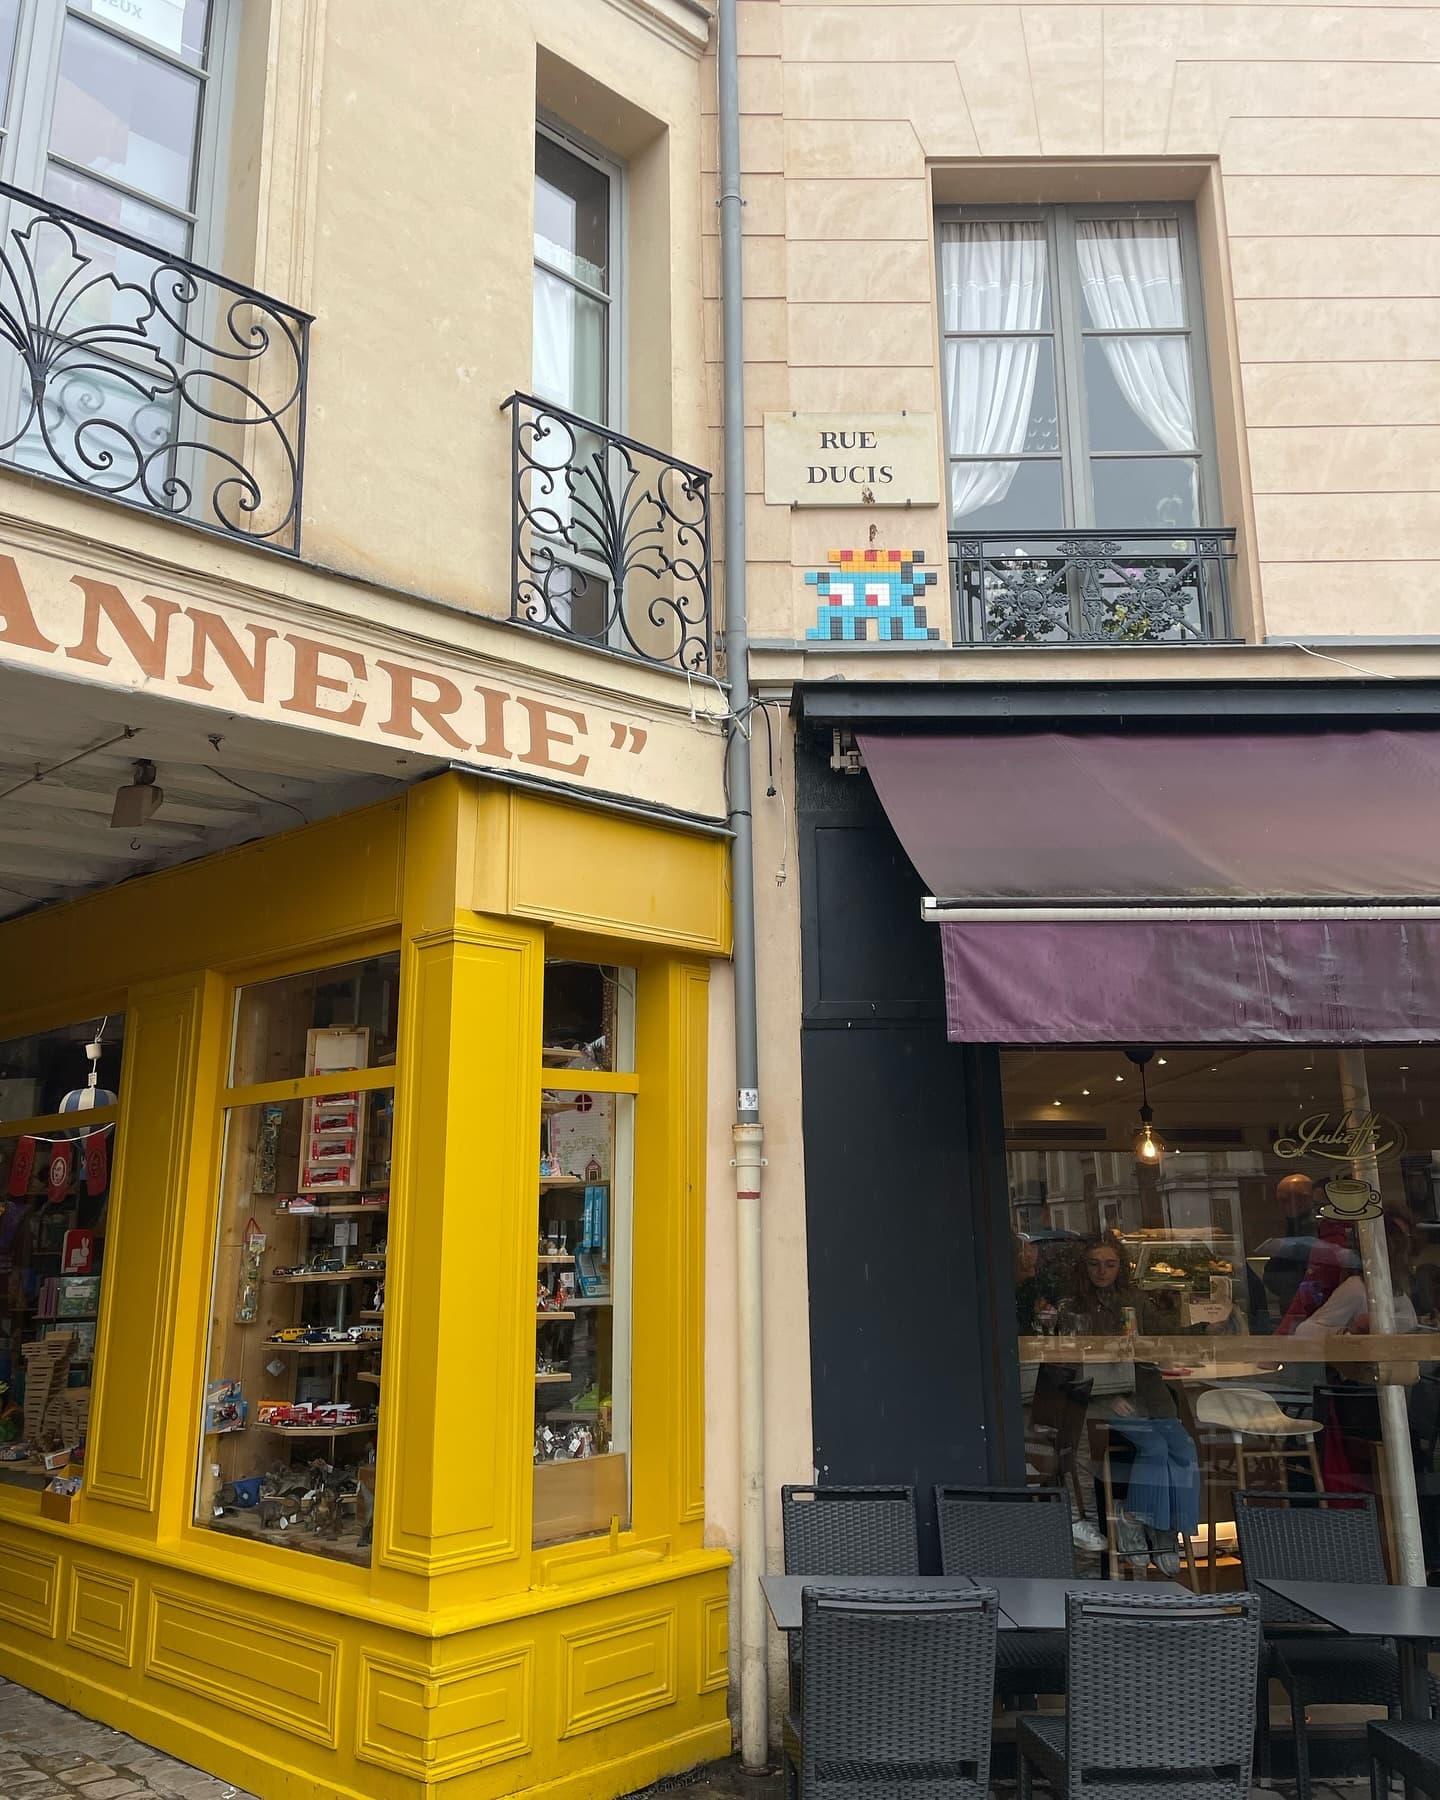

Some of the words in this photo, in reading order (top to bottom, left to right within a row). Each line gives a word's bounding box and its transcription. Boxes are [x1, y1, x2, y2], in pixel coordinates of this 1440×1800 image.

[102, 0, 142, 19] EUX
[820, 431, 877, 449] RUE
[807, 466, 893, 484] DUCIS
[1273, 1110, 1392, 1160] Juliette
